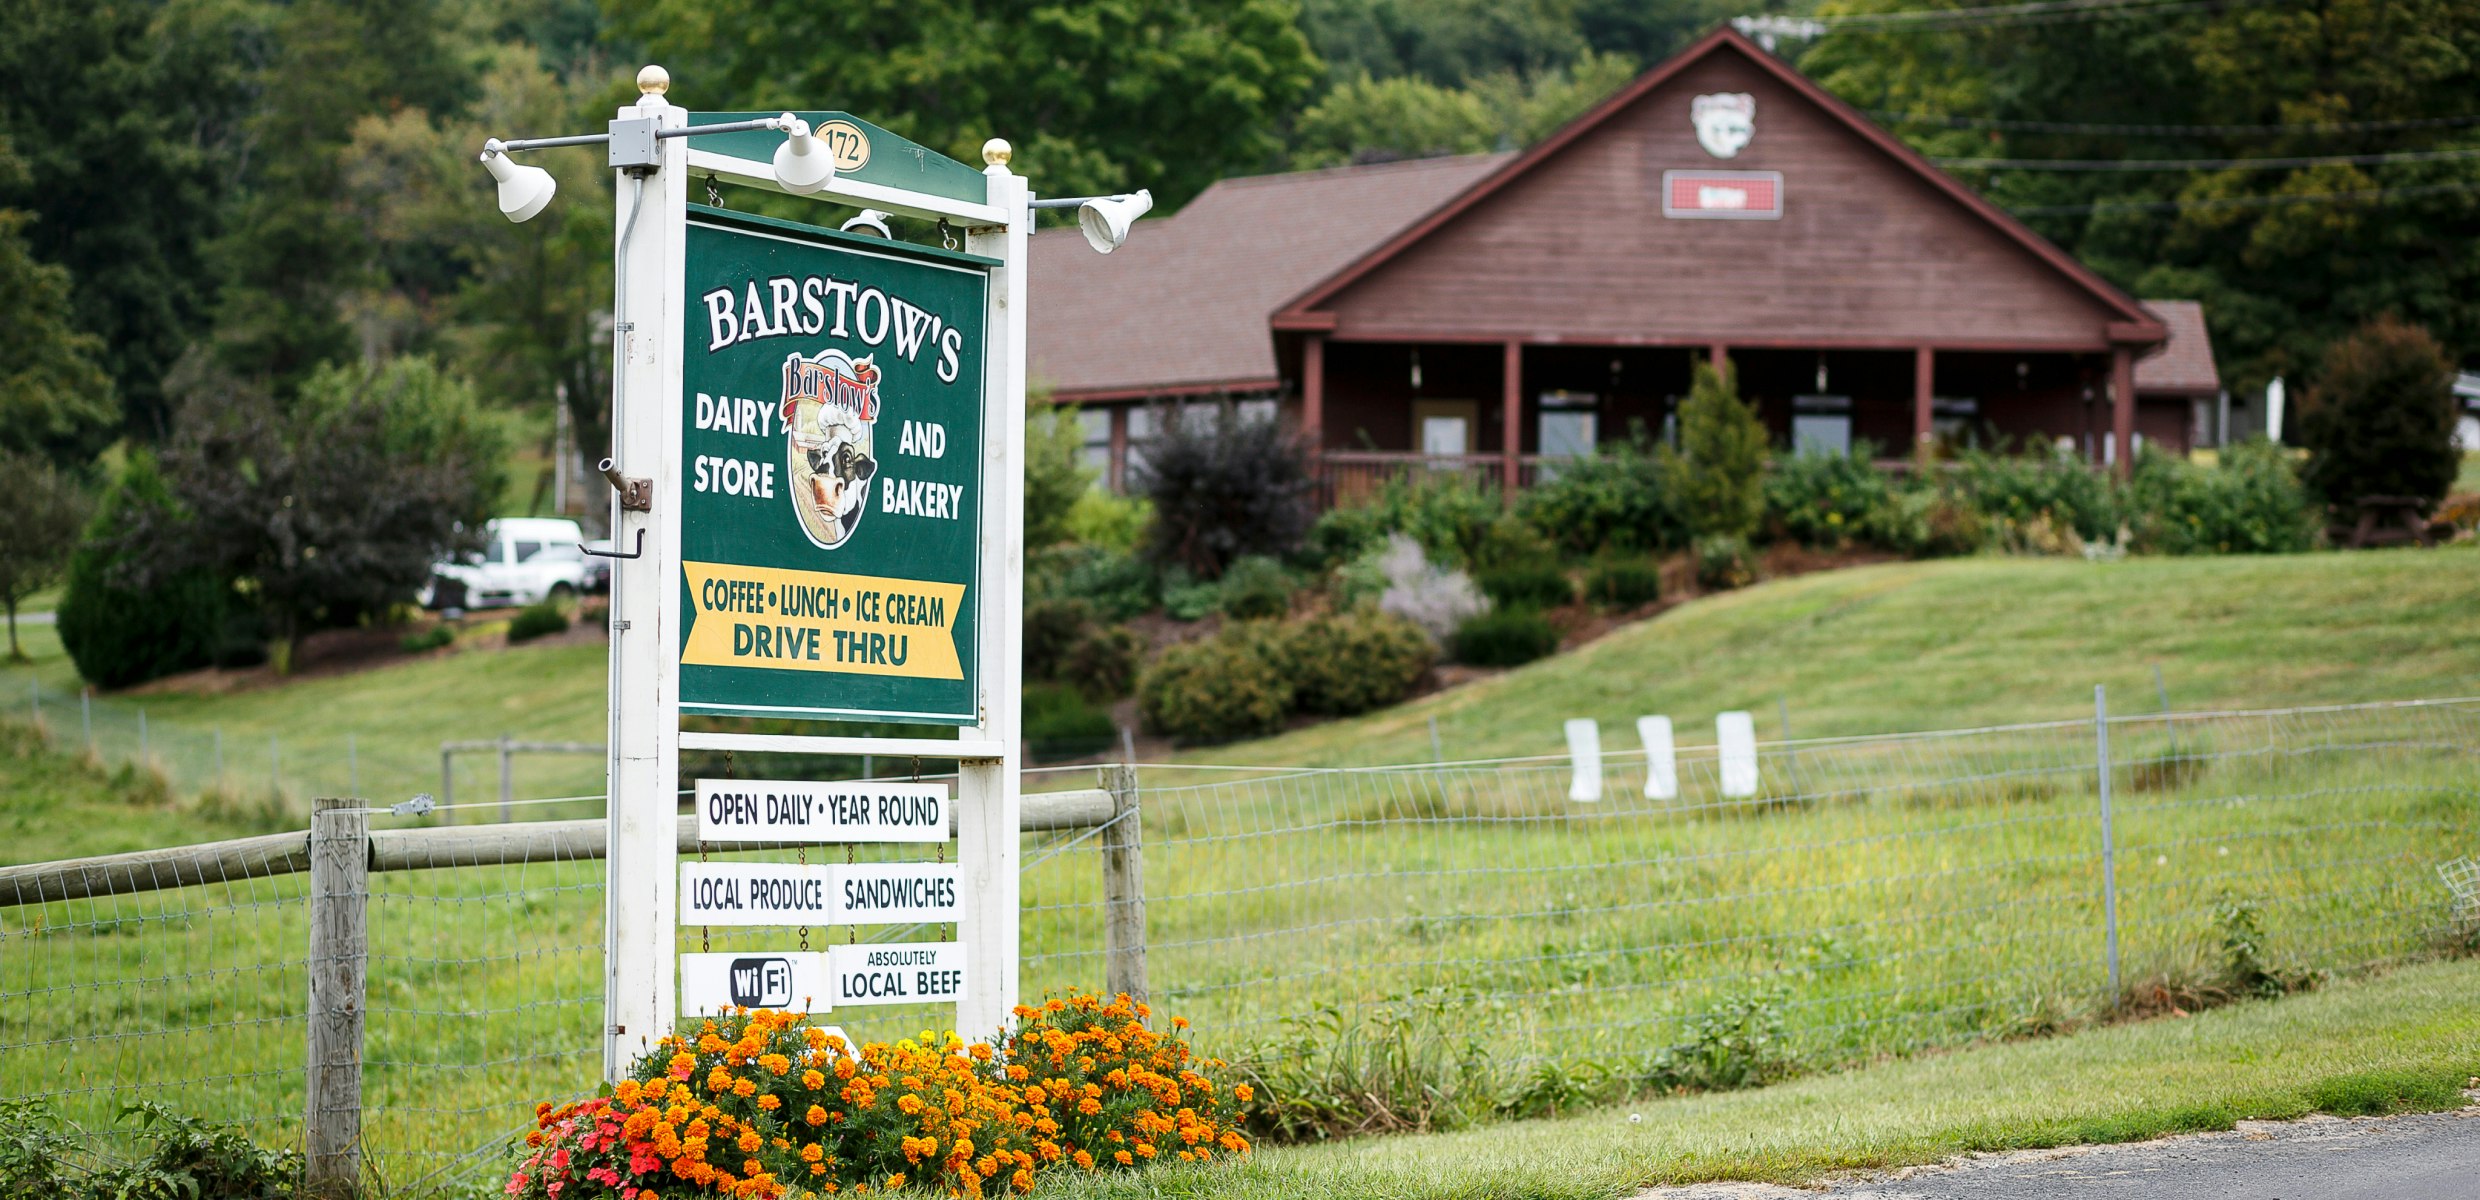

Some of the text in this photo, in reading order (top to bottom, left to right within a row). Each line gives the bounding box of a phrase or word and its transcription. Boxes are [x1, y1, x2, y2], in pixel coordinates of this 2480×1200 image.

[825, 129, 859, 161] 172
[703, 275, 962, 385] BARSTOW'S
[789, 357, 879, 417] Barstow's
[695, 393, 776, 437] DAIRY
[898, 420, 946, 459] AND
[693, 455, 775, 499] STORE
[882, 477, 963, 520] BAKERY
[702, 578, 944, 627] COFFEE LUNCH ICE CREAM
[733, 623, 908, 666] DRIVE THRU
[709, 793, 939, 826] OPEN DAILY YEAR ROUND
[693, 878, 823, 910] LOCAL PRODUCE
[845, 878, 955, 910] SANDWICHES
[867, 951, 937, 967] ABSOLUTELY
[842, 970, 961, 998] LOCAL BEEF
